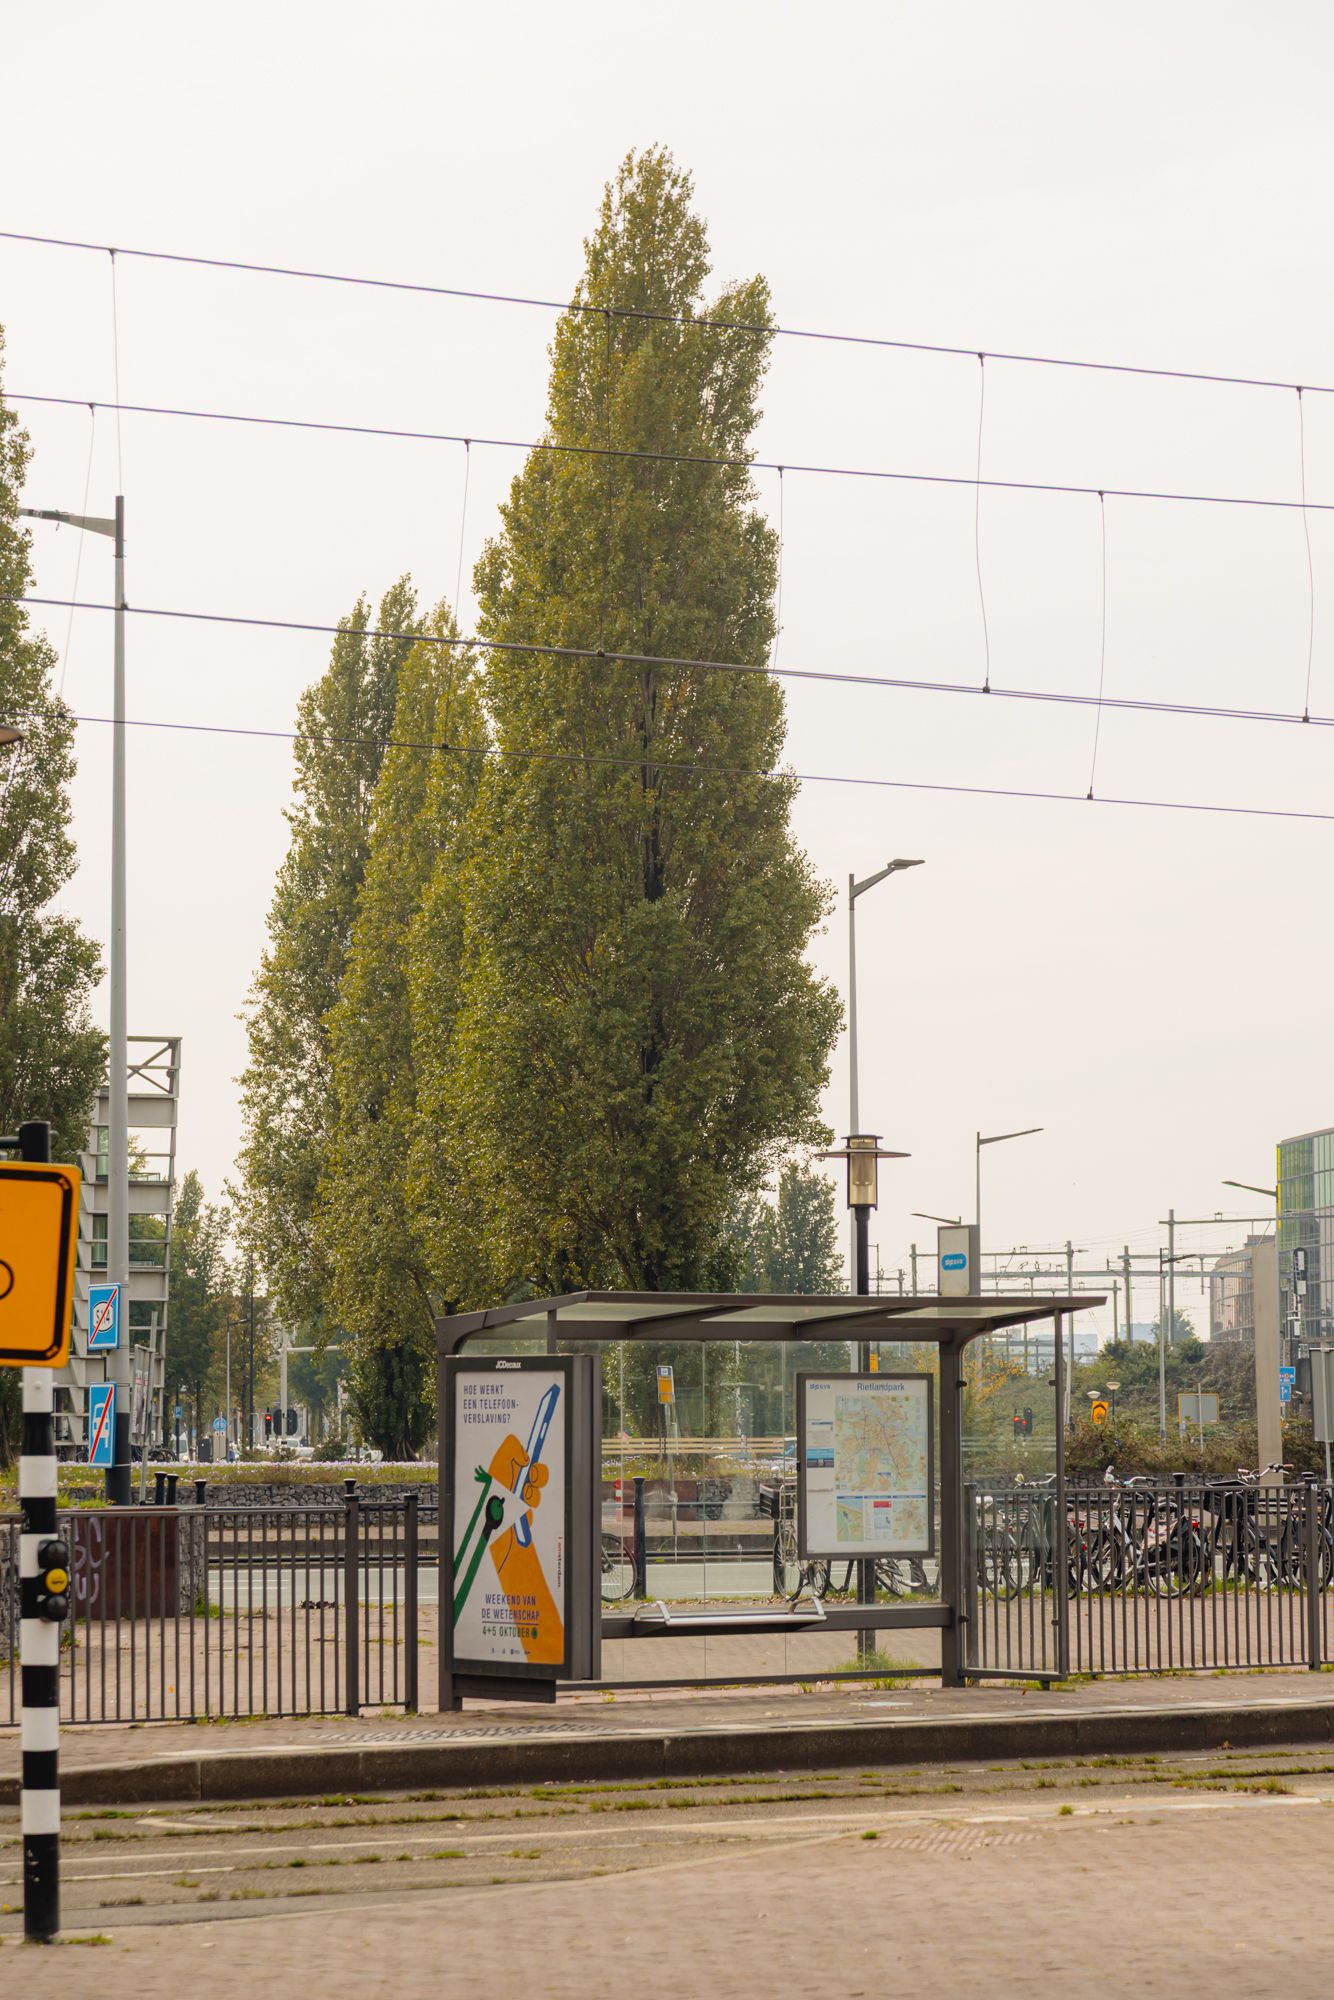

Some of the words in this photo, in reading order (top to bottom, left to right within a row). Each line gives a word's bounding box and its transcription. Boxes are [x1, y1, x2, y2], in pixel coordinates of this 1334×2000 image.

[496, 1360, 521, 1369] JCDecaux
[463, 1384, 477, 1395] HOE
[479, 1384, 504, 1395] WERKT
[856, 1382, 905, 1392] Rietlandpark
[463, 1399, 477, 1409] EEN
[480, 1399, 519, 1409] TELEFOON-
[463, 1413, 511, 1424] VERSLAVING?
[485, 1593, 521, 1606] WEEKEND
[522, 1594, 536, 1607] VAN
[481, 1607, 491, 1619] DE
[493, 1608, 540, 1621] WETENSCHAP
[482, 1625, 497, 1636] 4+5
[499, 1626, 530, 1639] OKTOBER
